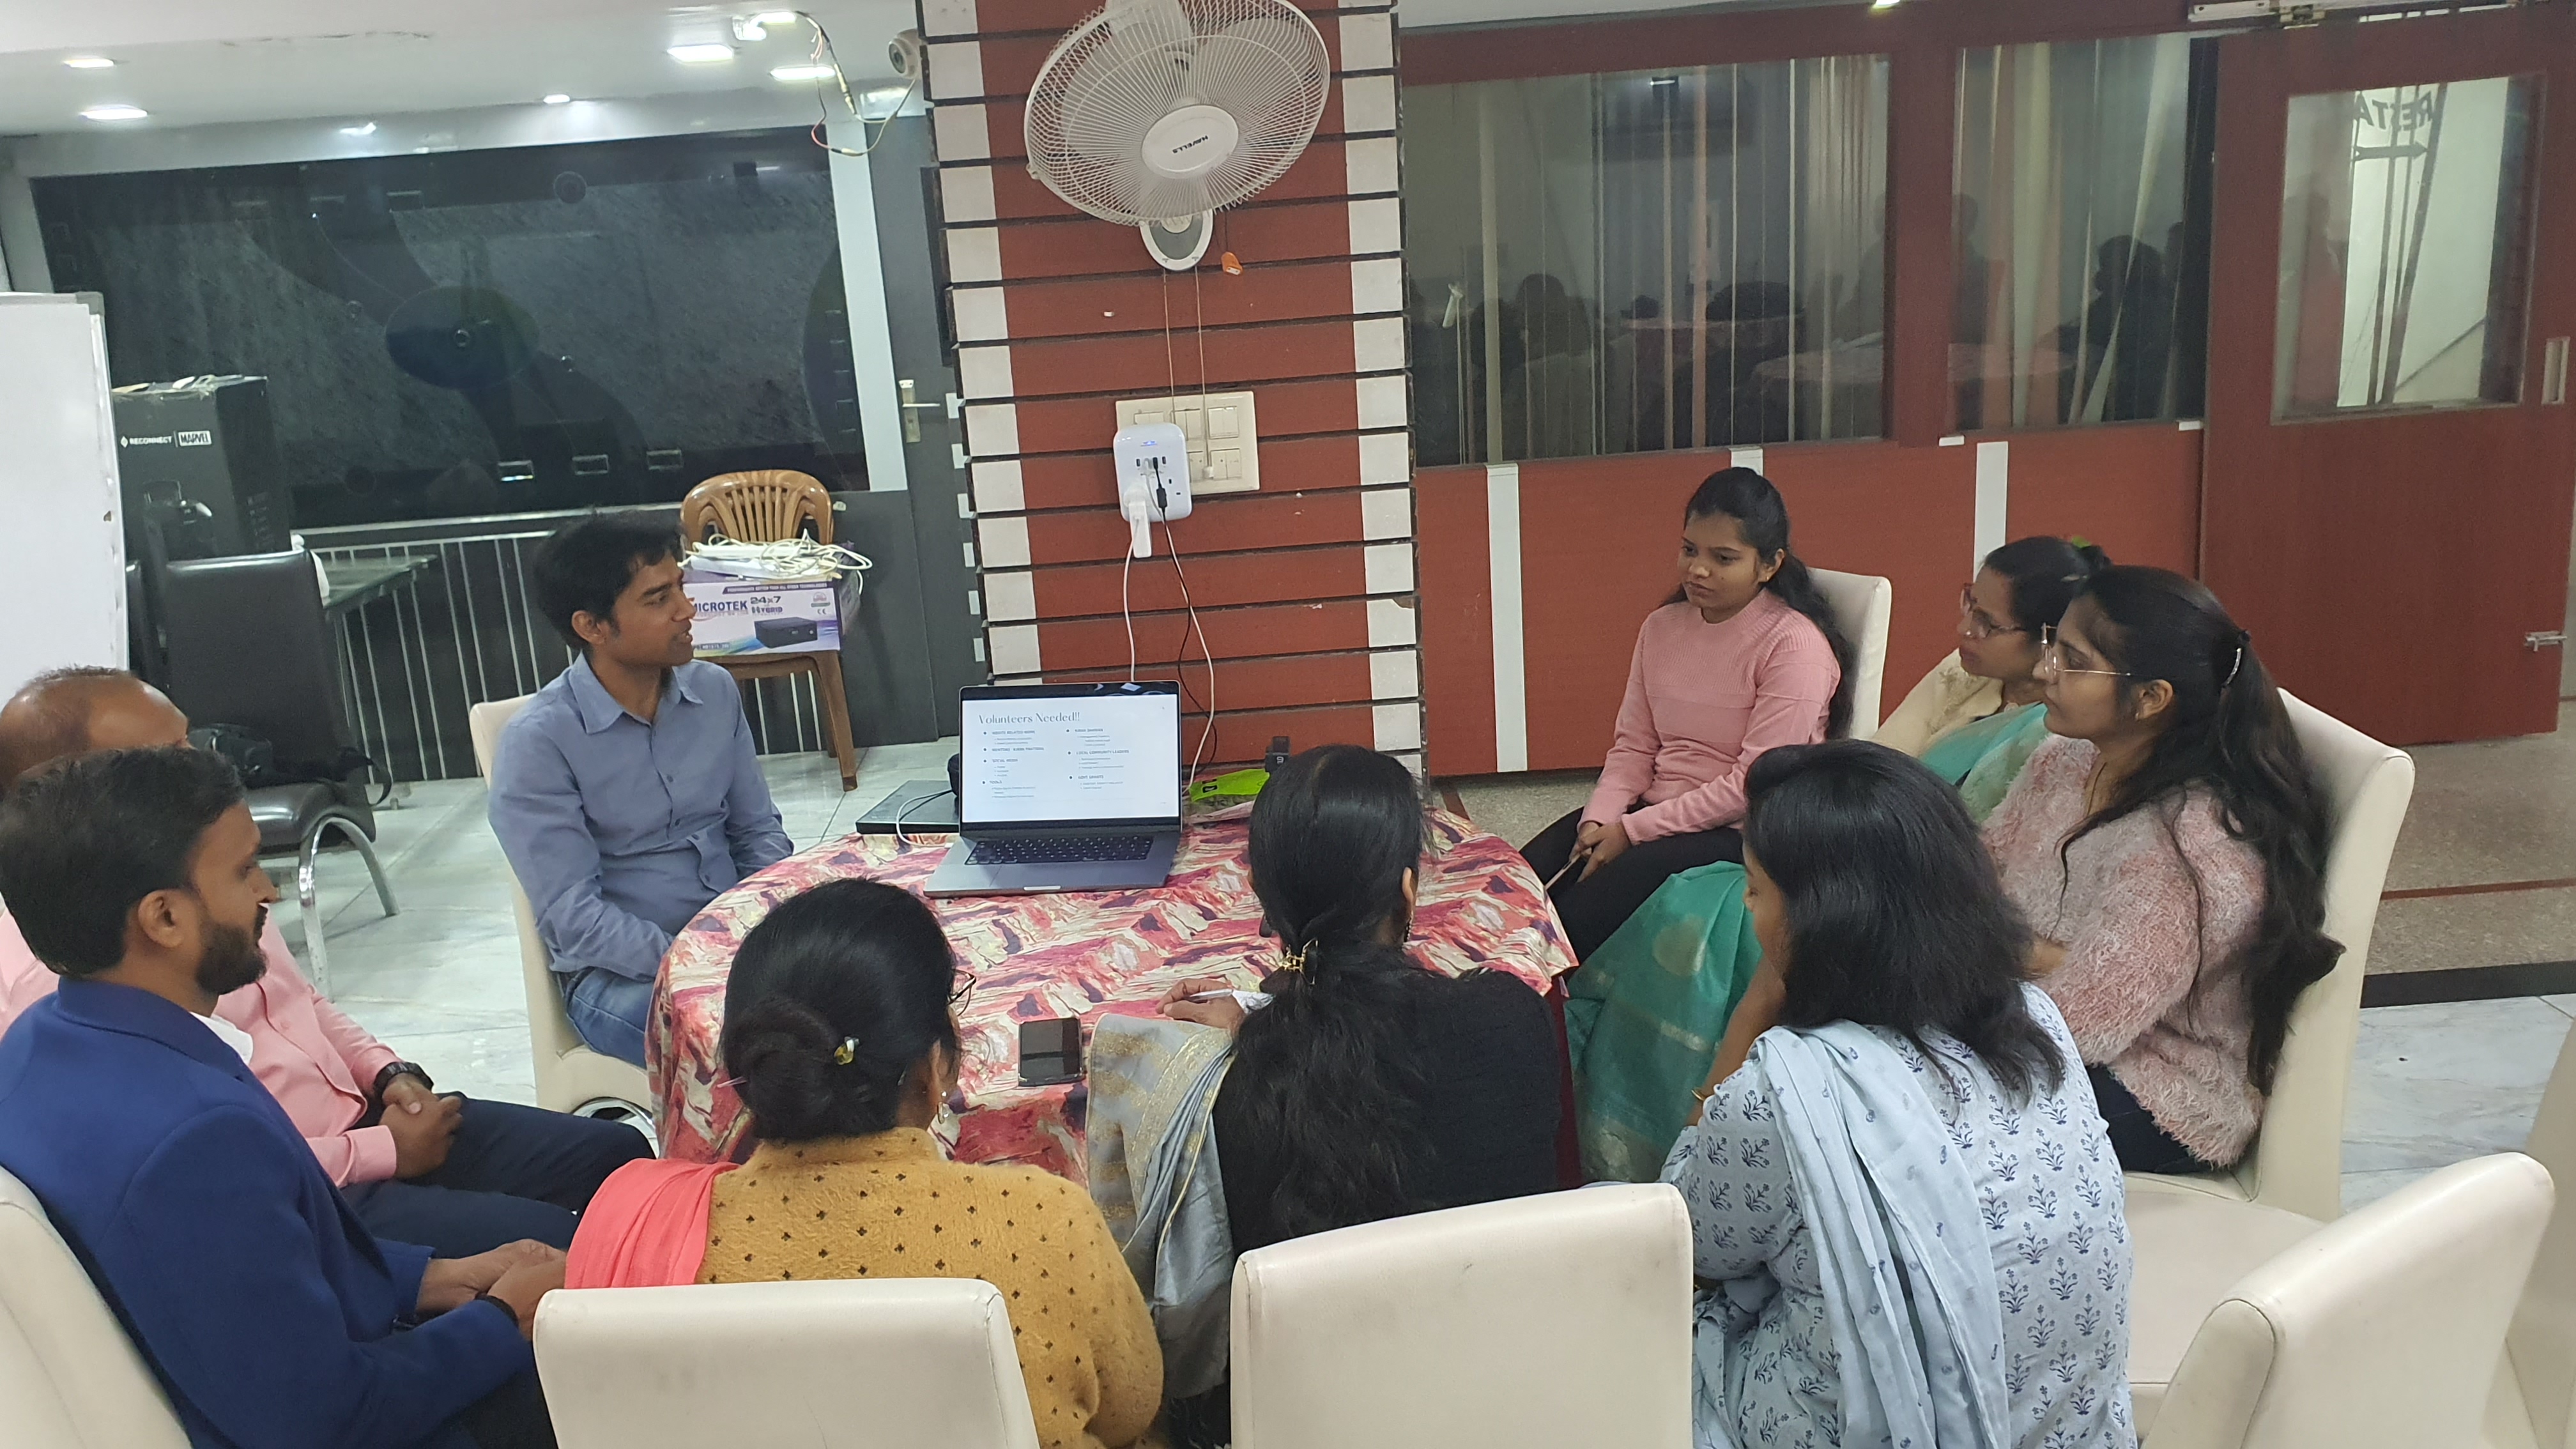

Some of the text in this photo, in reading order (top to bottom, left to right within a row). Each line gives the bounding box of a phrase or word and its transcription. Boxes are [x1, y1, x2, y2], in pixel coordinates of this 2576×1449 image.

[1172, 135, 1209, 154] HAVELLS
[129, 432, 211, 445] RECONNECT MARVEL
[979, 712, 1080, 724] Volunteers Needed!!
